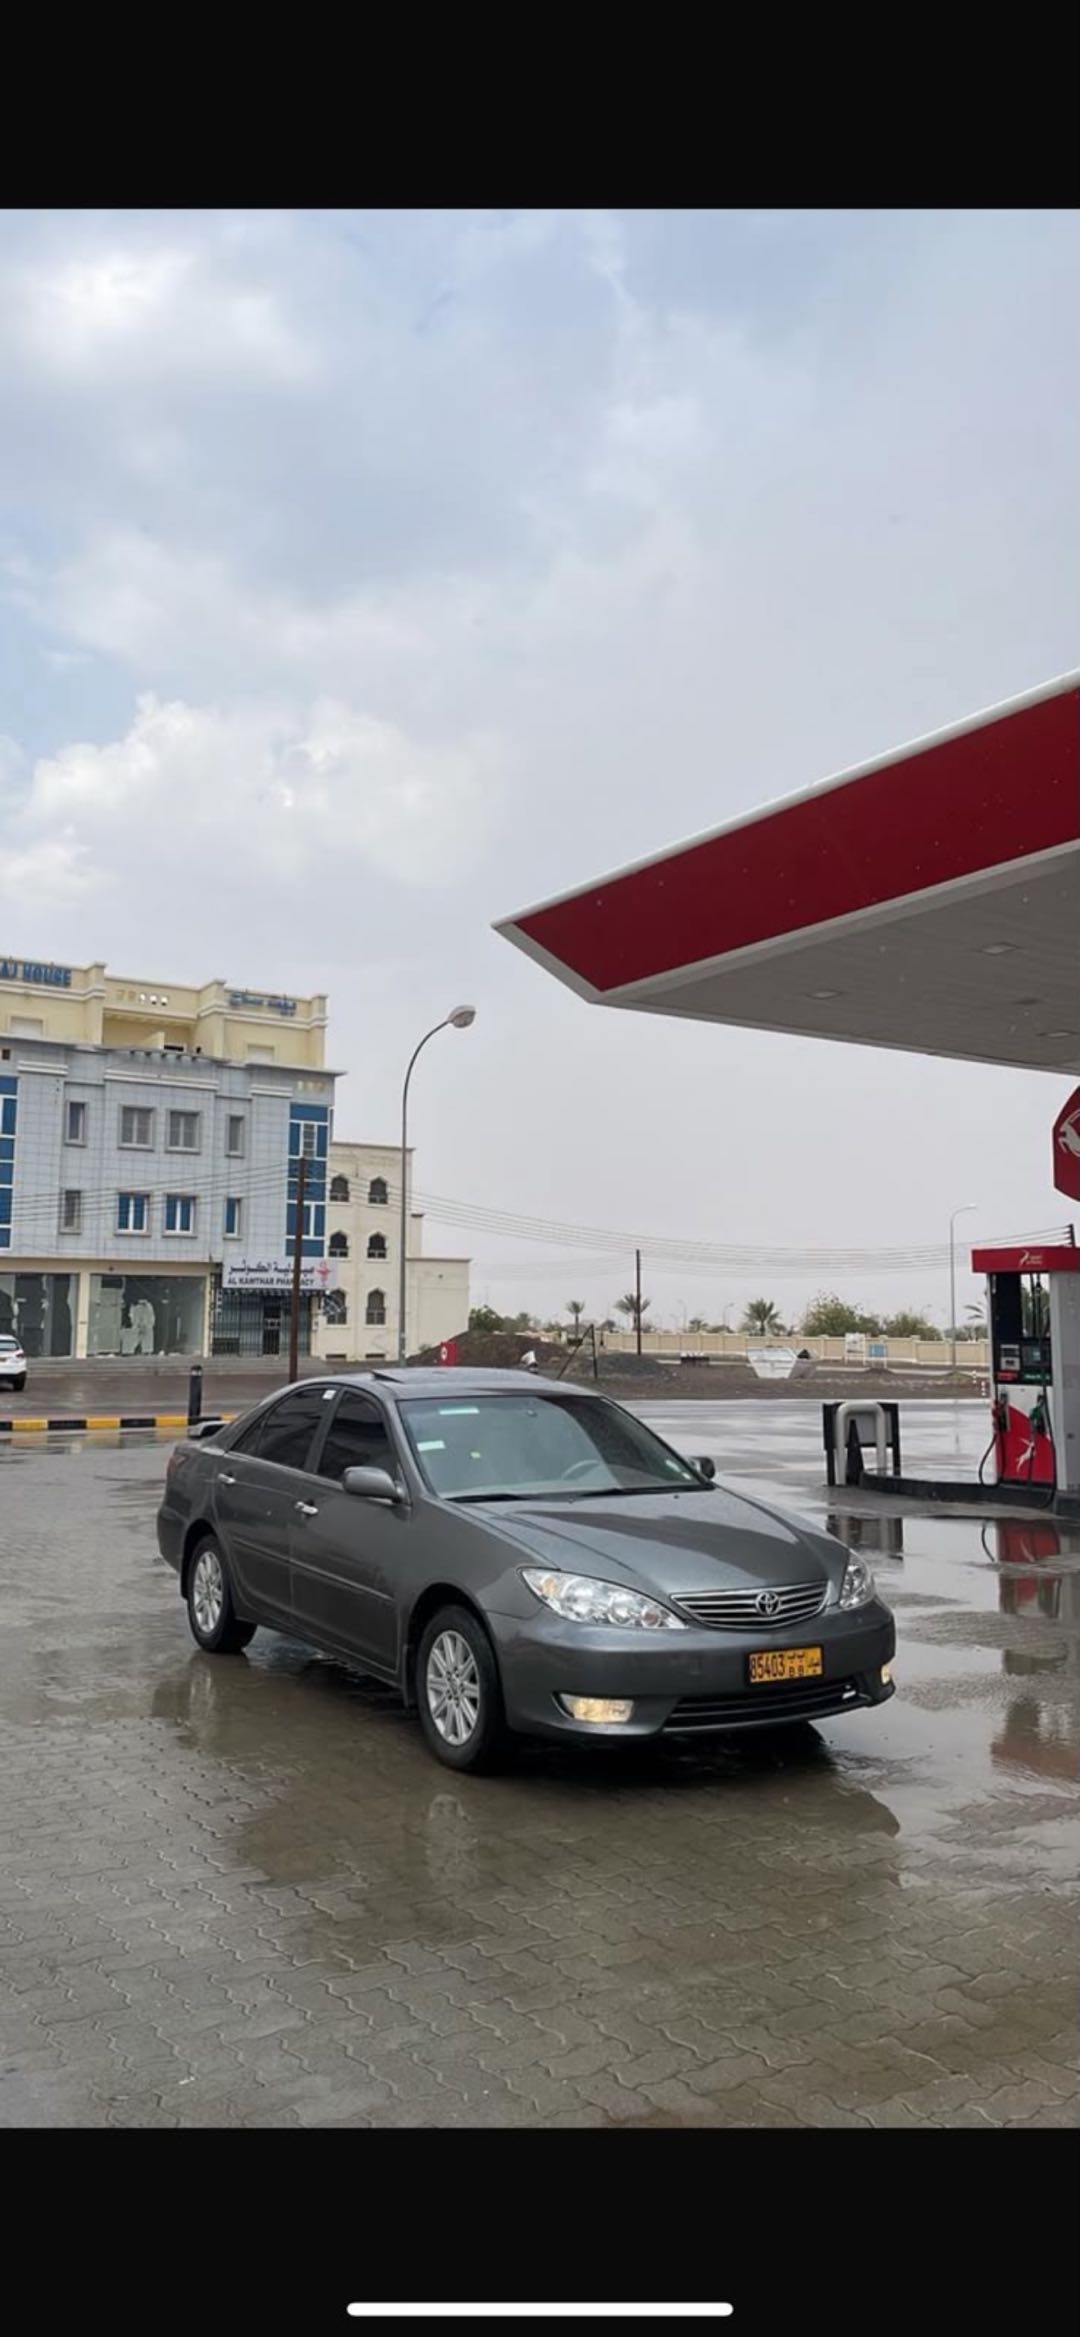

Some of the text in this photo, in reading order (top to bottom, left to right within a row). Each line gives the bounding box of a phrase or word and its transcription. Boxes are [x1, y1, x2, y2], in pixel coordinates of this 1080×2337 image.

[23, 962, 71, 988] HOUSE
[228, 1277, 237, 1285] AL
[751, 1654, 785, 1679] 85403
